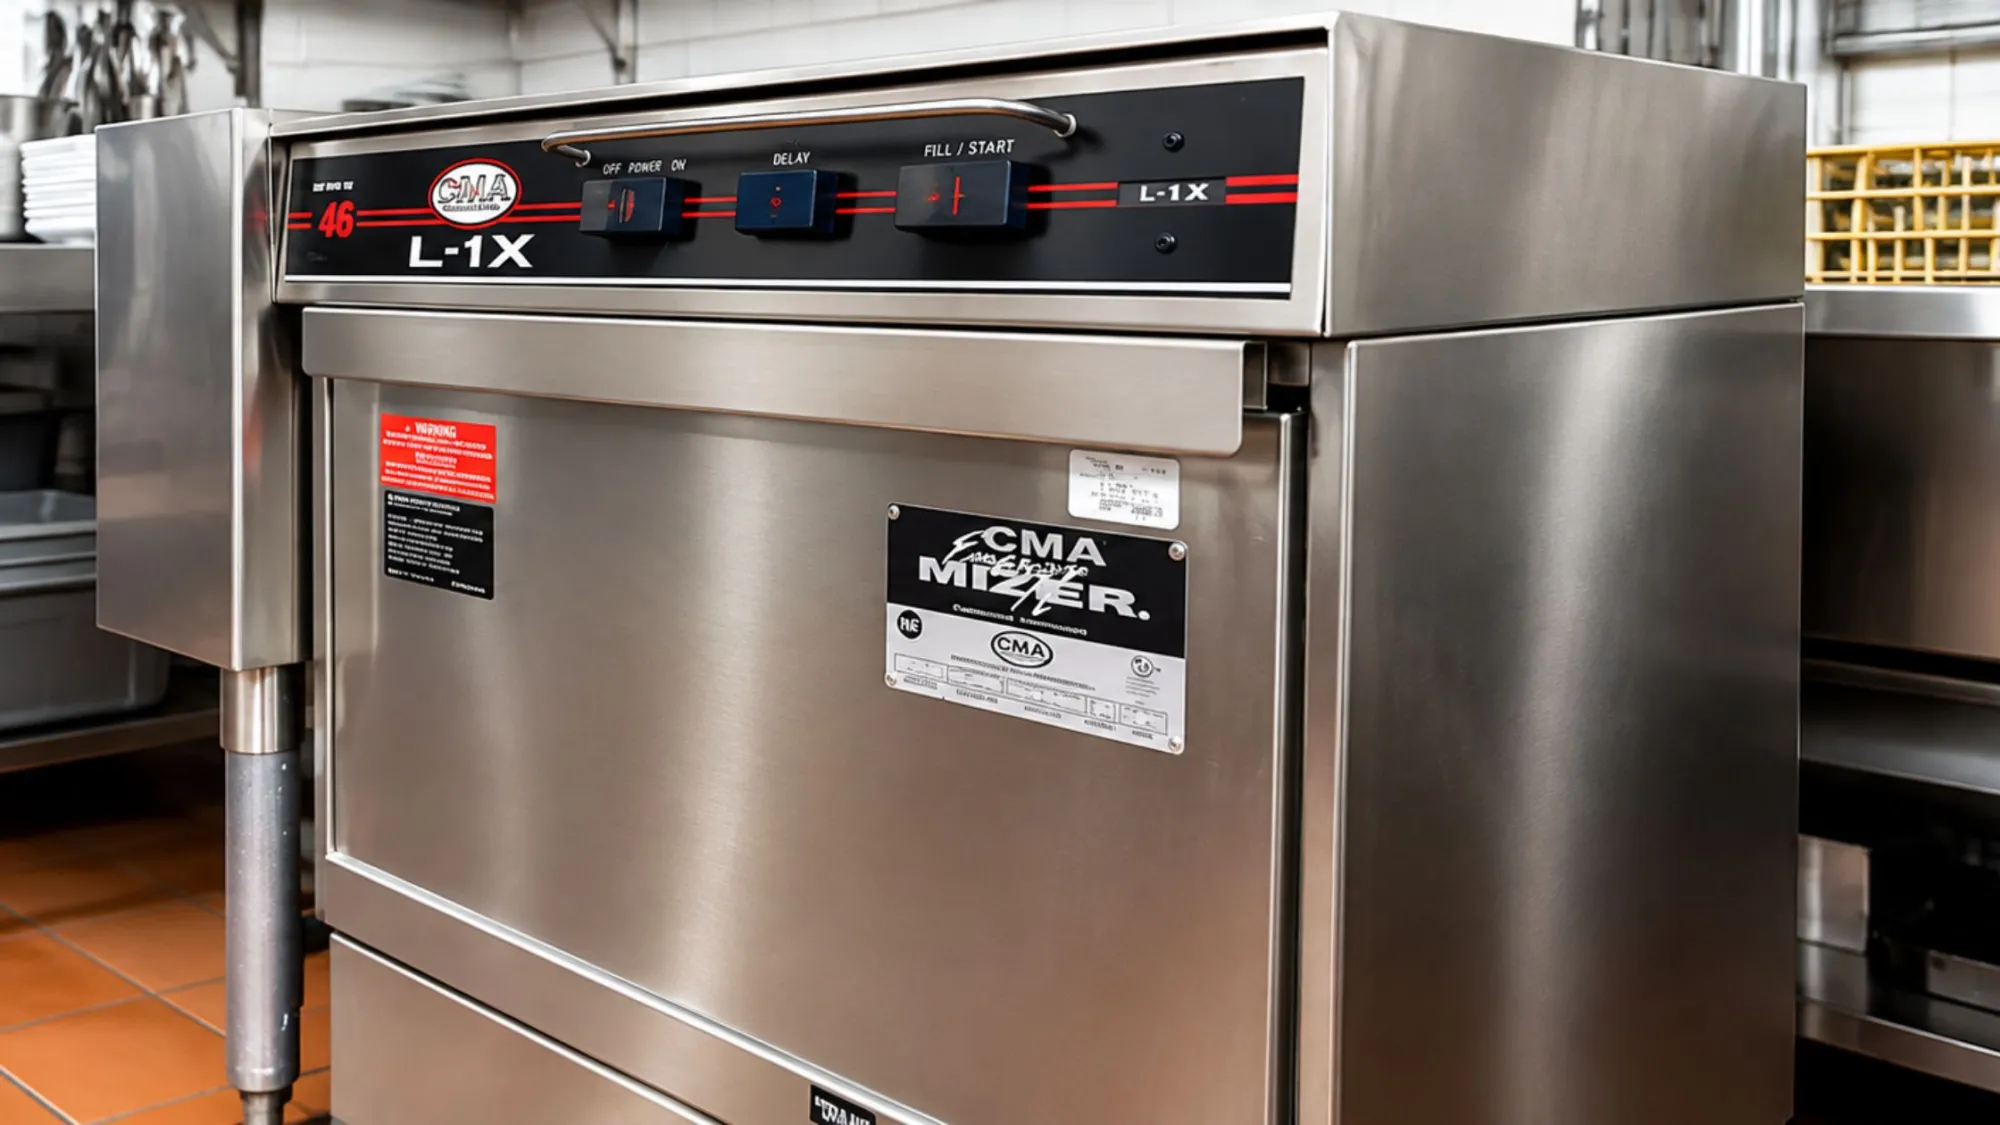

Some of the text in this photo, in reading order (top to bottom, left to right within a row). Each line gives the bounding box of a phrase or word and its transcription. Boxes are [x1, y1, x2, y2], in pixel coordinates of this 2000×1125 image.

[924, 143, 952, 157] FILL
[968, 138, 1015, 155] START
[603, 159, 687, 175] OFF POWER ON
[773, 152, 811, 166] DELAY
[1139, 182, 1209, 202] L-1X
[318, 200, 355, 238] 46
[409, 234, 535, 268] L-1X
[982, 525, 1107, 567] CMA
[997, 636, 1045, 658] CMA
